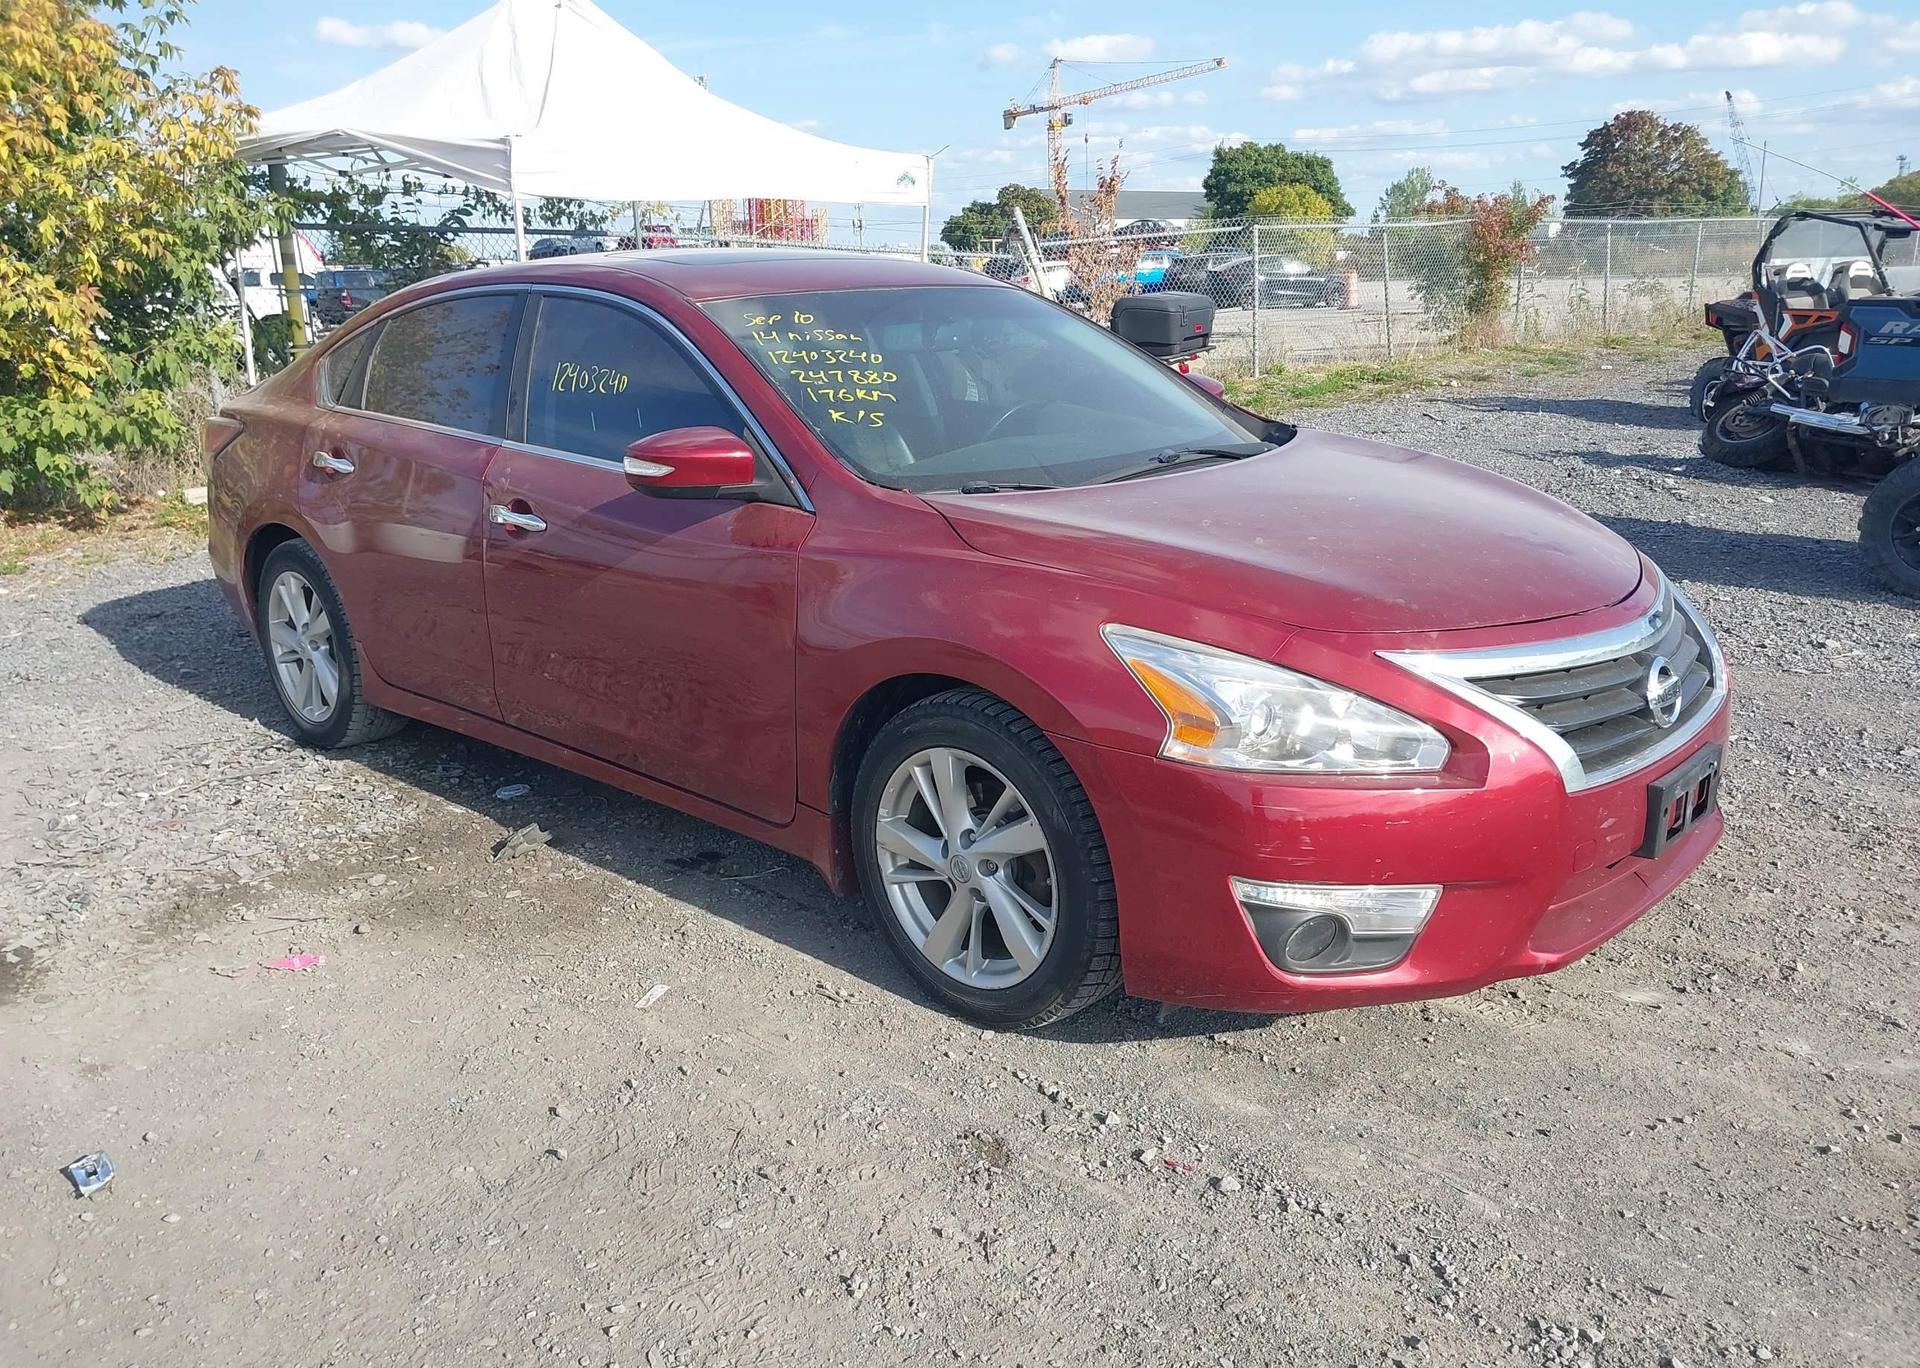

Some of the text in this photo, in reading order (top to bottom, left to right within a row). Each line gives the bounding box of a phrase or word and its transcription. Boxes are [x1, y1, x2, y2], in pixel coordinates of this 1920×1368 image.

[794, 311, 814, 325] 10
[752, 331, 781, 346] 14
[768, 350, 883, 365] 12403240
[551, 361, 628, 396] 12403240
[790, 369, 897, 385] 247880
